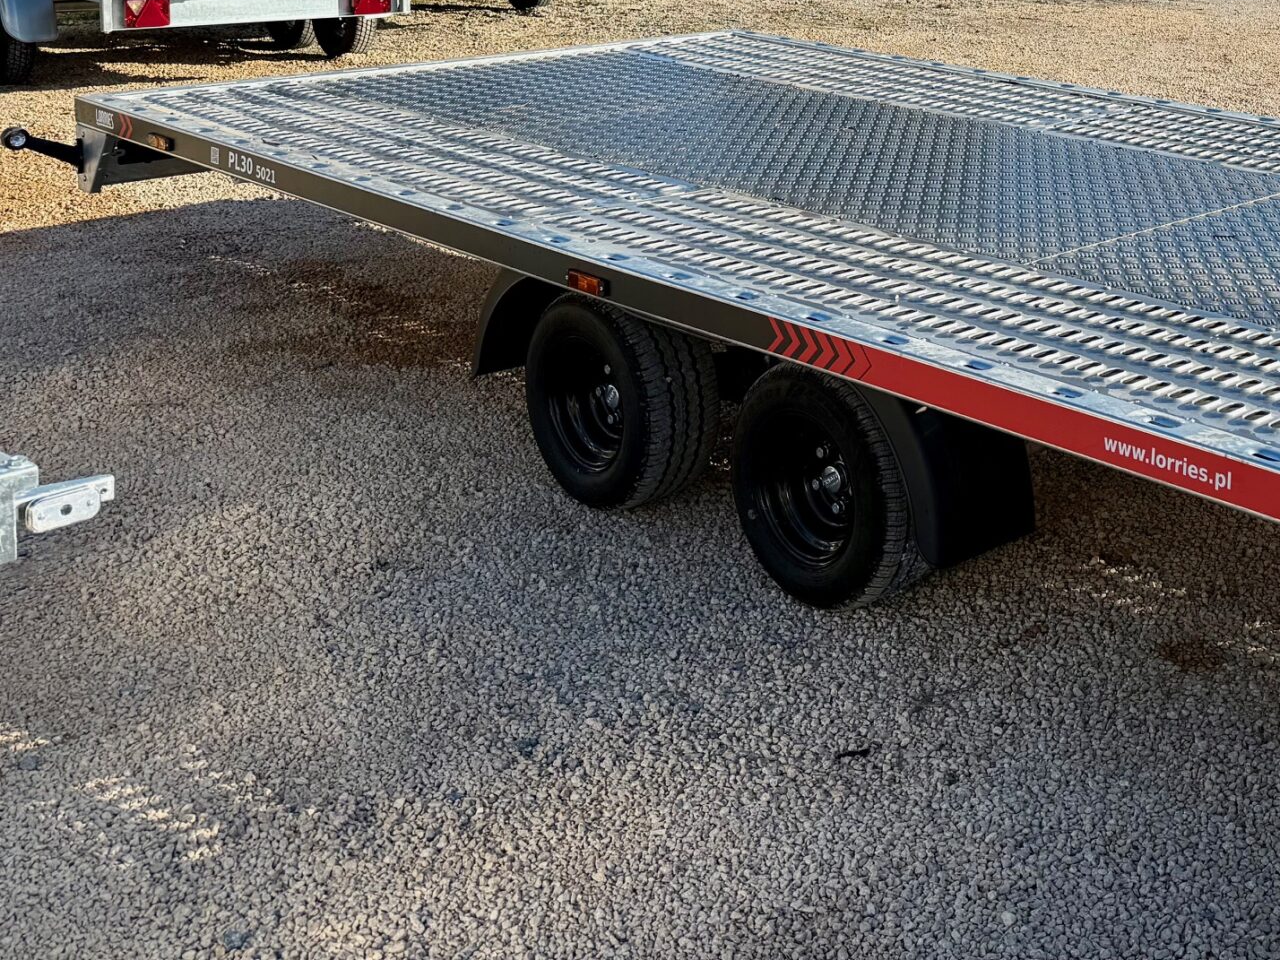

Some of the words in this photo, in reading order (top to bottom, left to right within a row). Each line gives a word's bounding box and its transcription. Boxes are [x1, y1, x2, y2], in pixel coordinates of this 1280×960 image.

[228, 151, 254, 175] PL30
[255, 165, 276, 184] 5021
[1103, 437, 1232, 491] www.lorries.pl
